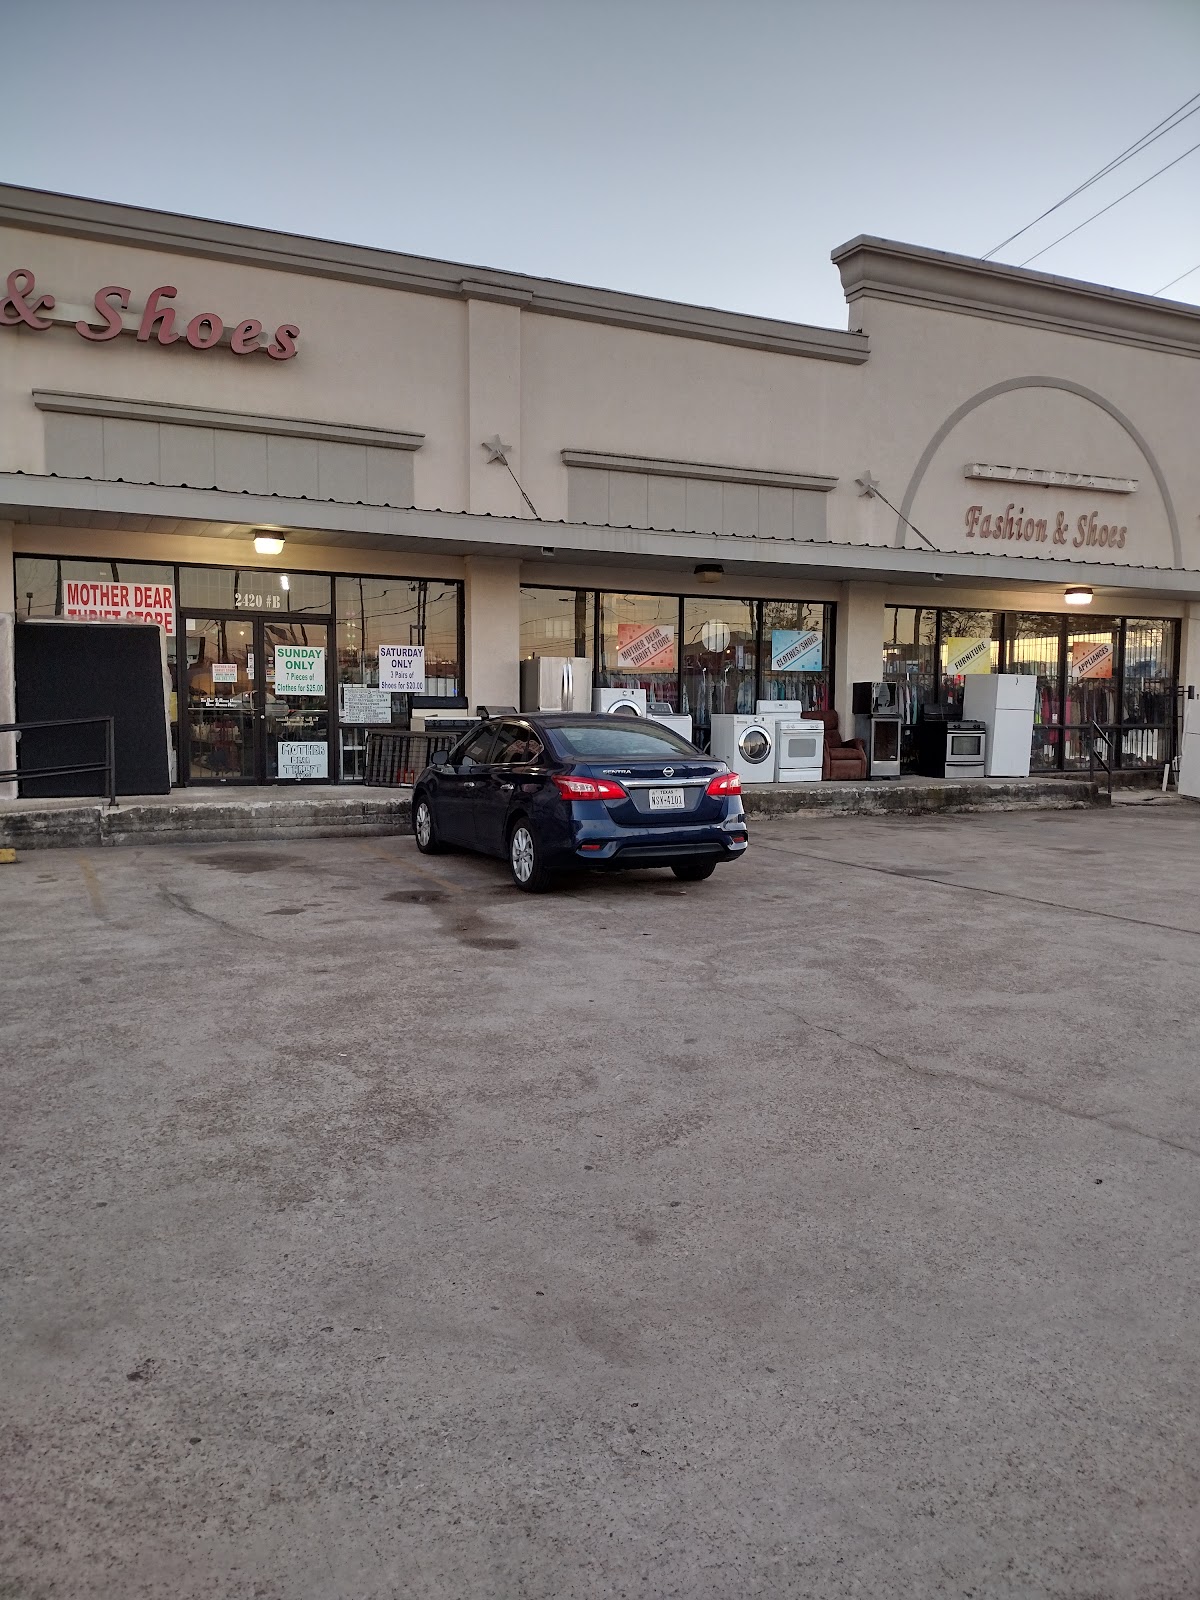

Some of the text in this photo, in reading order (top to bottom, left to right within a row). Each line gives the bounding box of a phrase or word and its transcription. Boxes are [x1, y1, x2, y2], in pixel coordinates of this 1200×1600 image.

[0, 269, 300, 360] & Shoes
[965, 503, 1128, 548] Fashion & Shoes
[67, 583, 172, 608] MOTHER DEAR
[235, 593, 280, 608] 2420 #B
[621, 628, 662, 661] MOTHER DEAR
[631, 633, 671, 666] THRIFT STORE
[776, 633, 819, 668] CLOTHES/SHOES
[277, 648, 322, 658] SUNDAY
[380, 647, 423, 657] SATURDAY
[954, 641, 987, 670] FURNITURE
[1078, 645, 1109, 673] APPLIANCES
[285, 660, 315, 670] ONLY
[391, 659, 413, 668] ONLY
[286, 672, 315, 681] 7 Pieces of
[394, 670, 408, 679] Pairs
[409, 671, 415, 679] of
[277, 683, 297, 692] Clothes
[306, 684, 324, 692] $25.00
[381, 681, 424, 690] Shoes for $20.00
[281, 743, 325, 756] MOTHER
